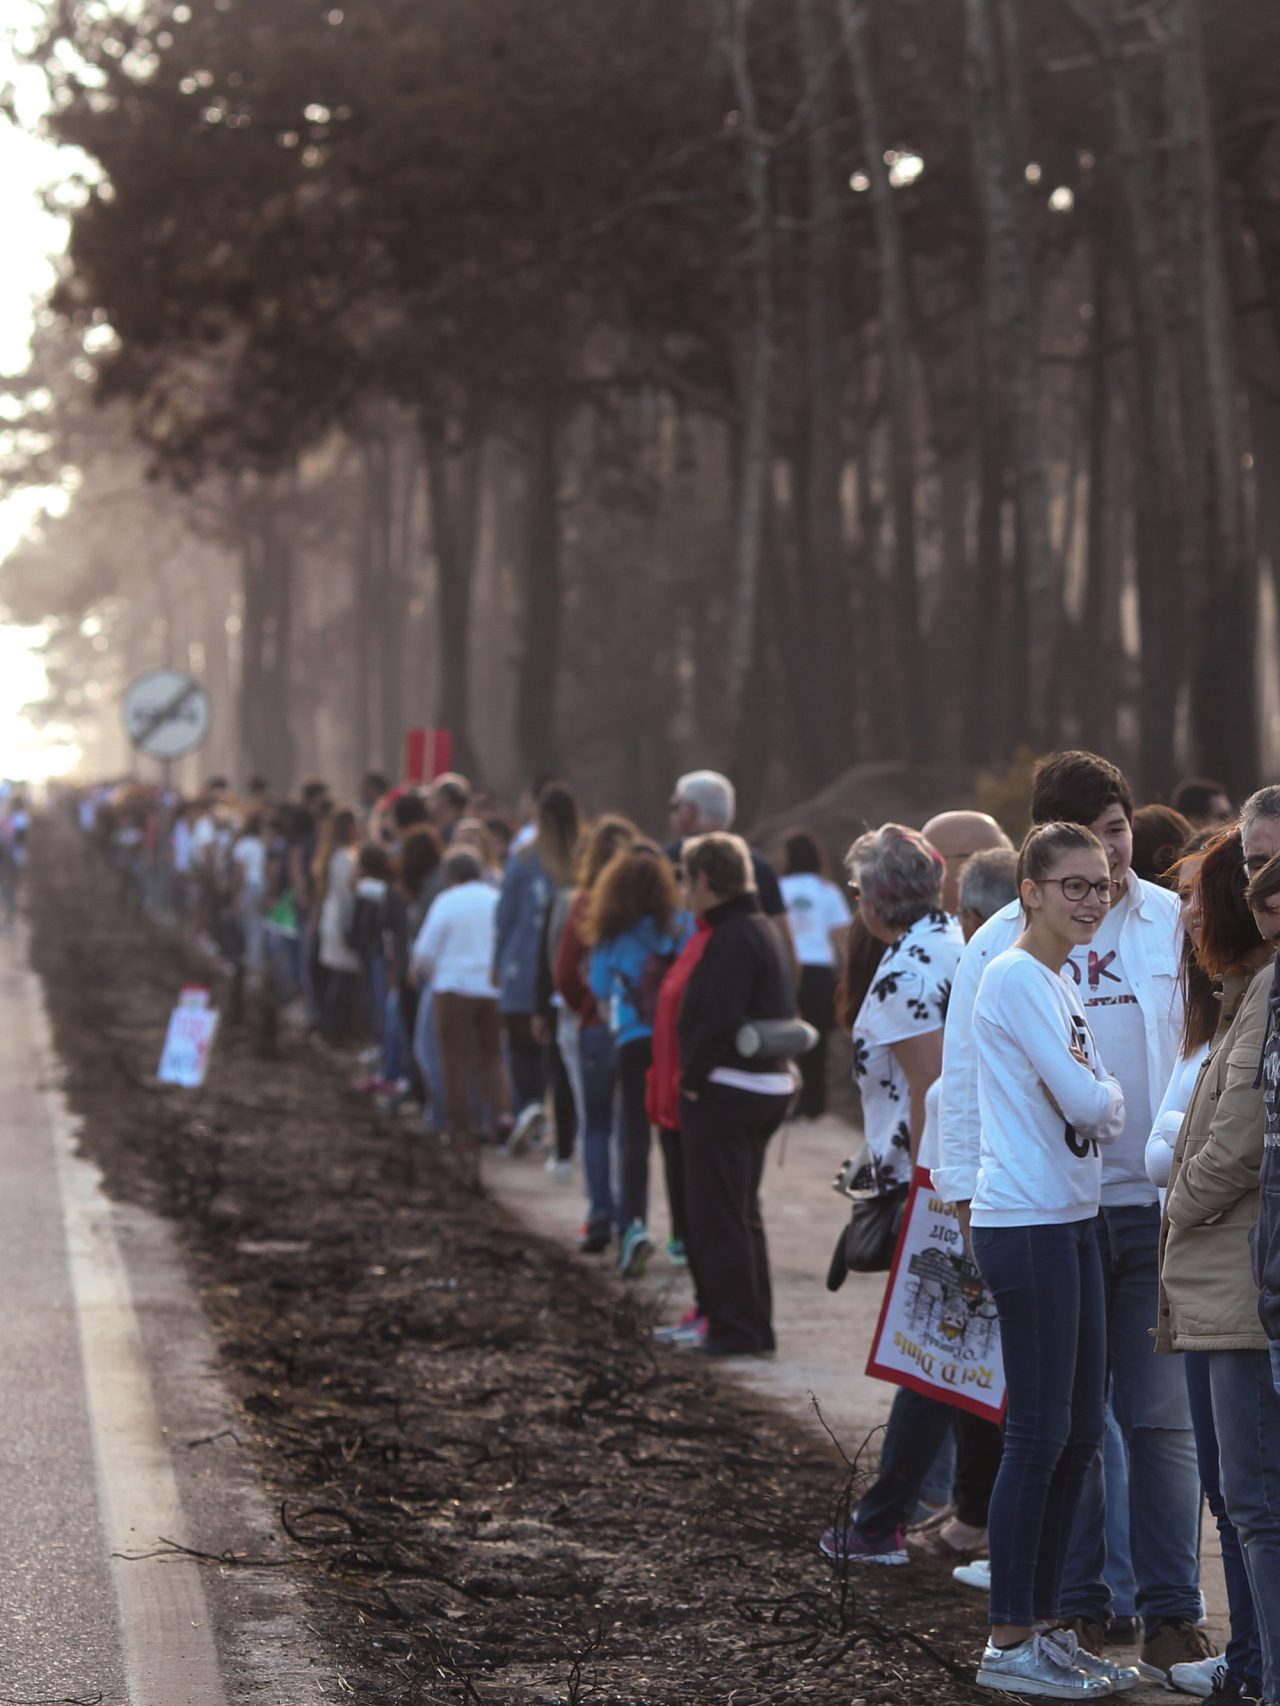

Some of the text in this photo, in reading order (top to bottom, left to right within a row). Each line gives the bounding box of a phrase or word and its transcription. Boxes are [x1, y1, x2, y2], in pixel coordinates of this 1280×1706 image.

[929, 1224, 959, 1245] 2017
[893, 1331, 936, 1378] Dinis
[940, 1361, 958, 1387] D.
[960, 1365, 993, 1389] Rei
